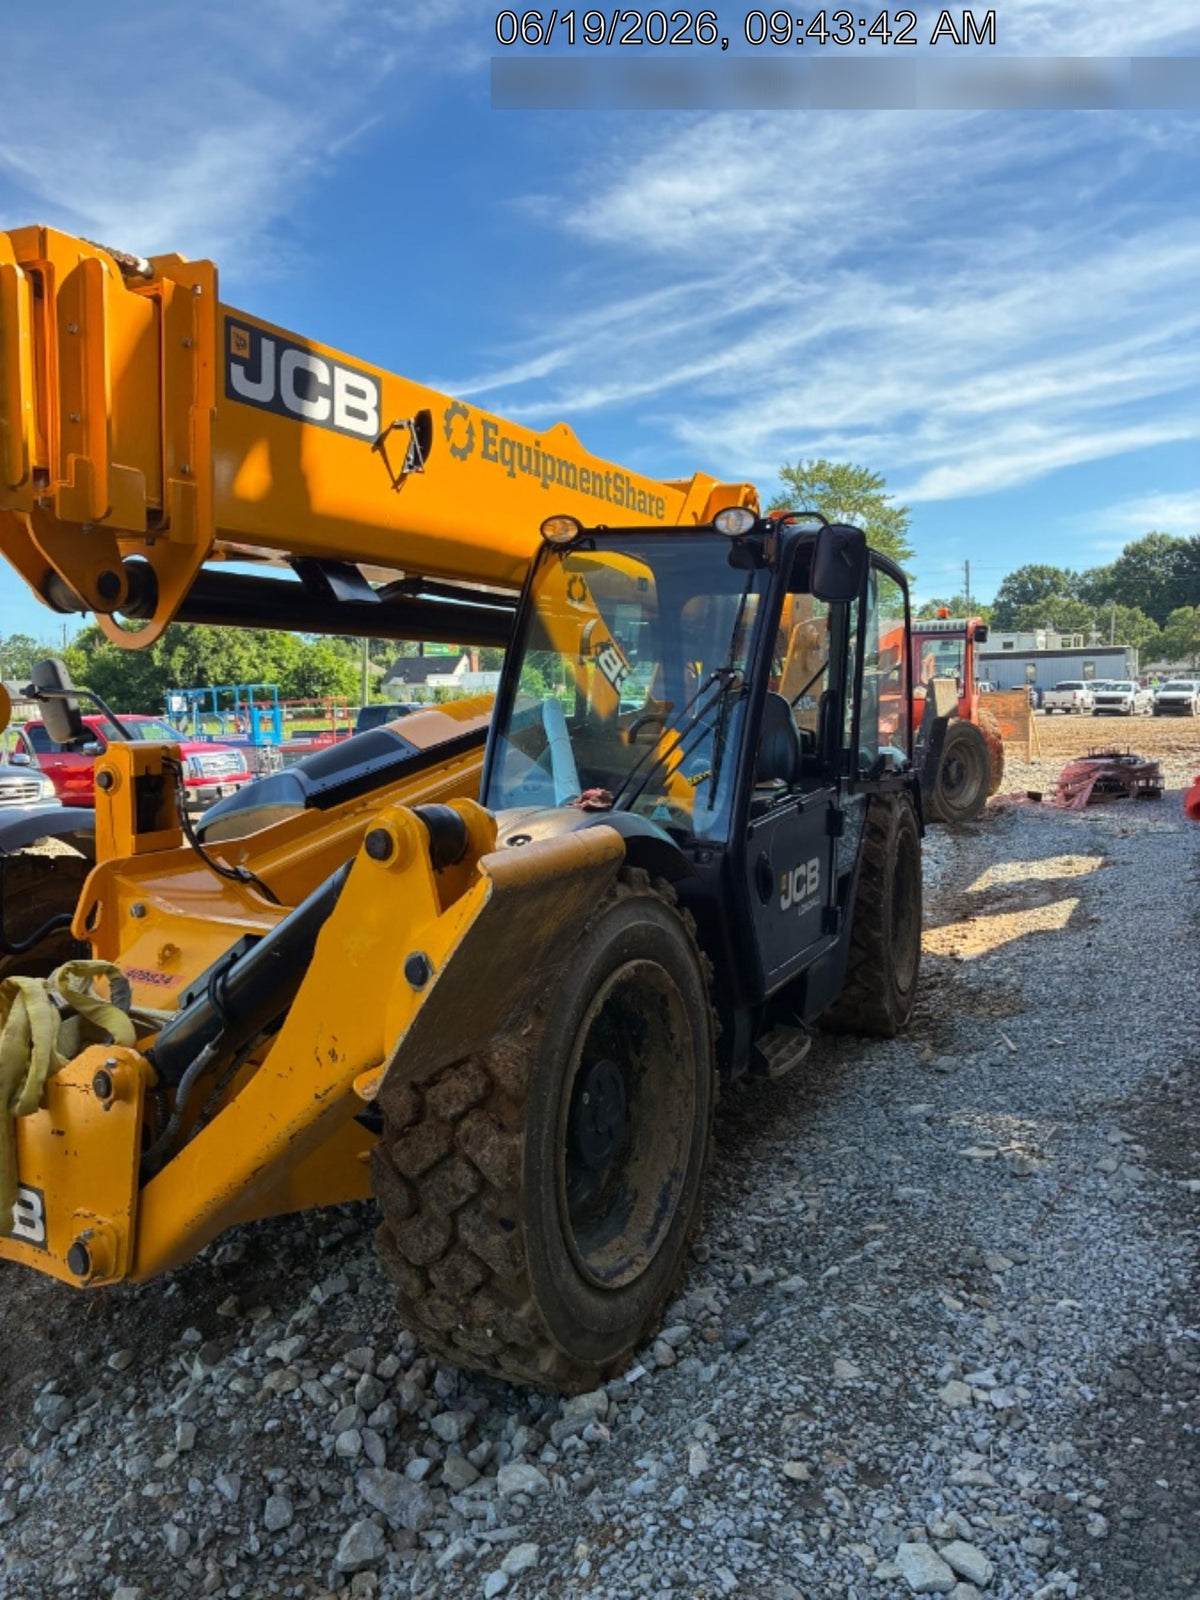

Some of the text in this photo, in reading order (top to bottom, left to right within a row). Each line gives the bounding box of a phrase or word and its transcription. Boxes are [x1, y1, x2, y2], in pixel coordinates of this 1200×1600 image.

[230, 337, 379, 438] JCB
[481, 418, 666, 520] EquipmentShare
[780, 856, 820, 911] JCB
